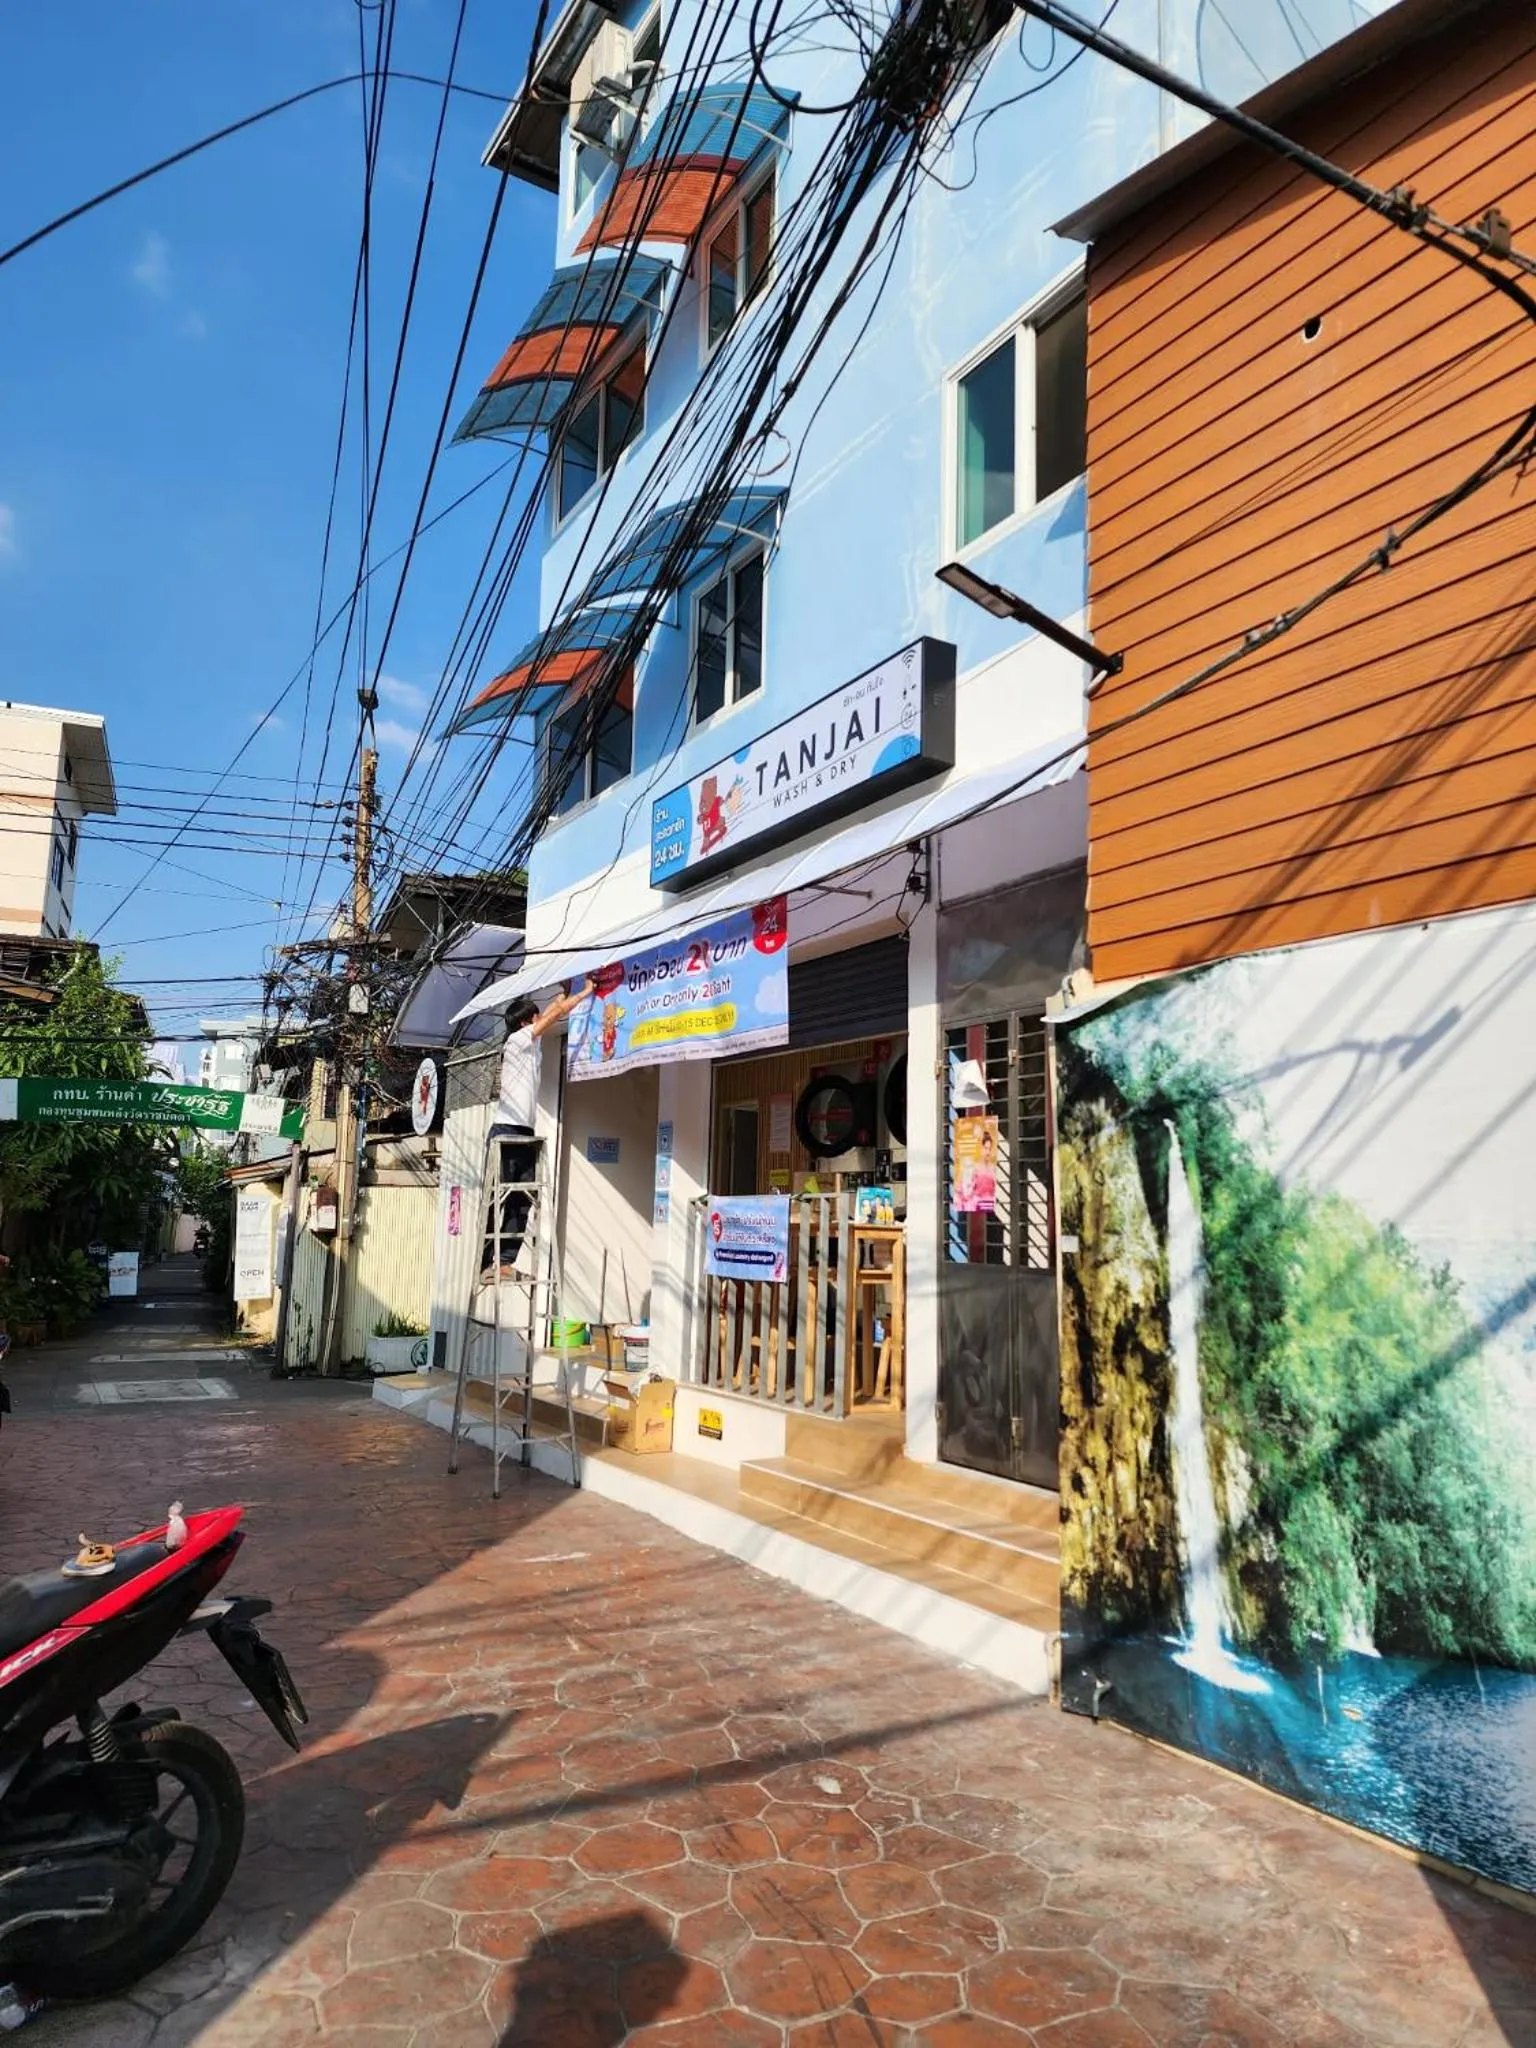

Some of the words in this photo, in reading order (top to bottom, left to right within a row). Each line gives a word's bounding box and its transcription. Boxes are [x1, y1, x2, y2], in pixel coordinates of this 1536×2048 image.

[755, 696, 883, 796] TANJAI
[772, 781, 809, 808] WASH
[815, 776, 823, 792] &
[830, 754, 858, 782] DRY
[654, 847, 667, 868] 24
[96, 1085, 143, 1101] ร้านค้า
